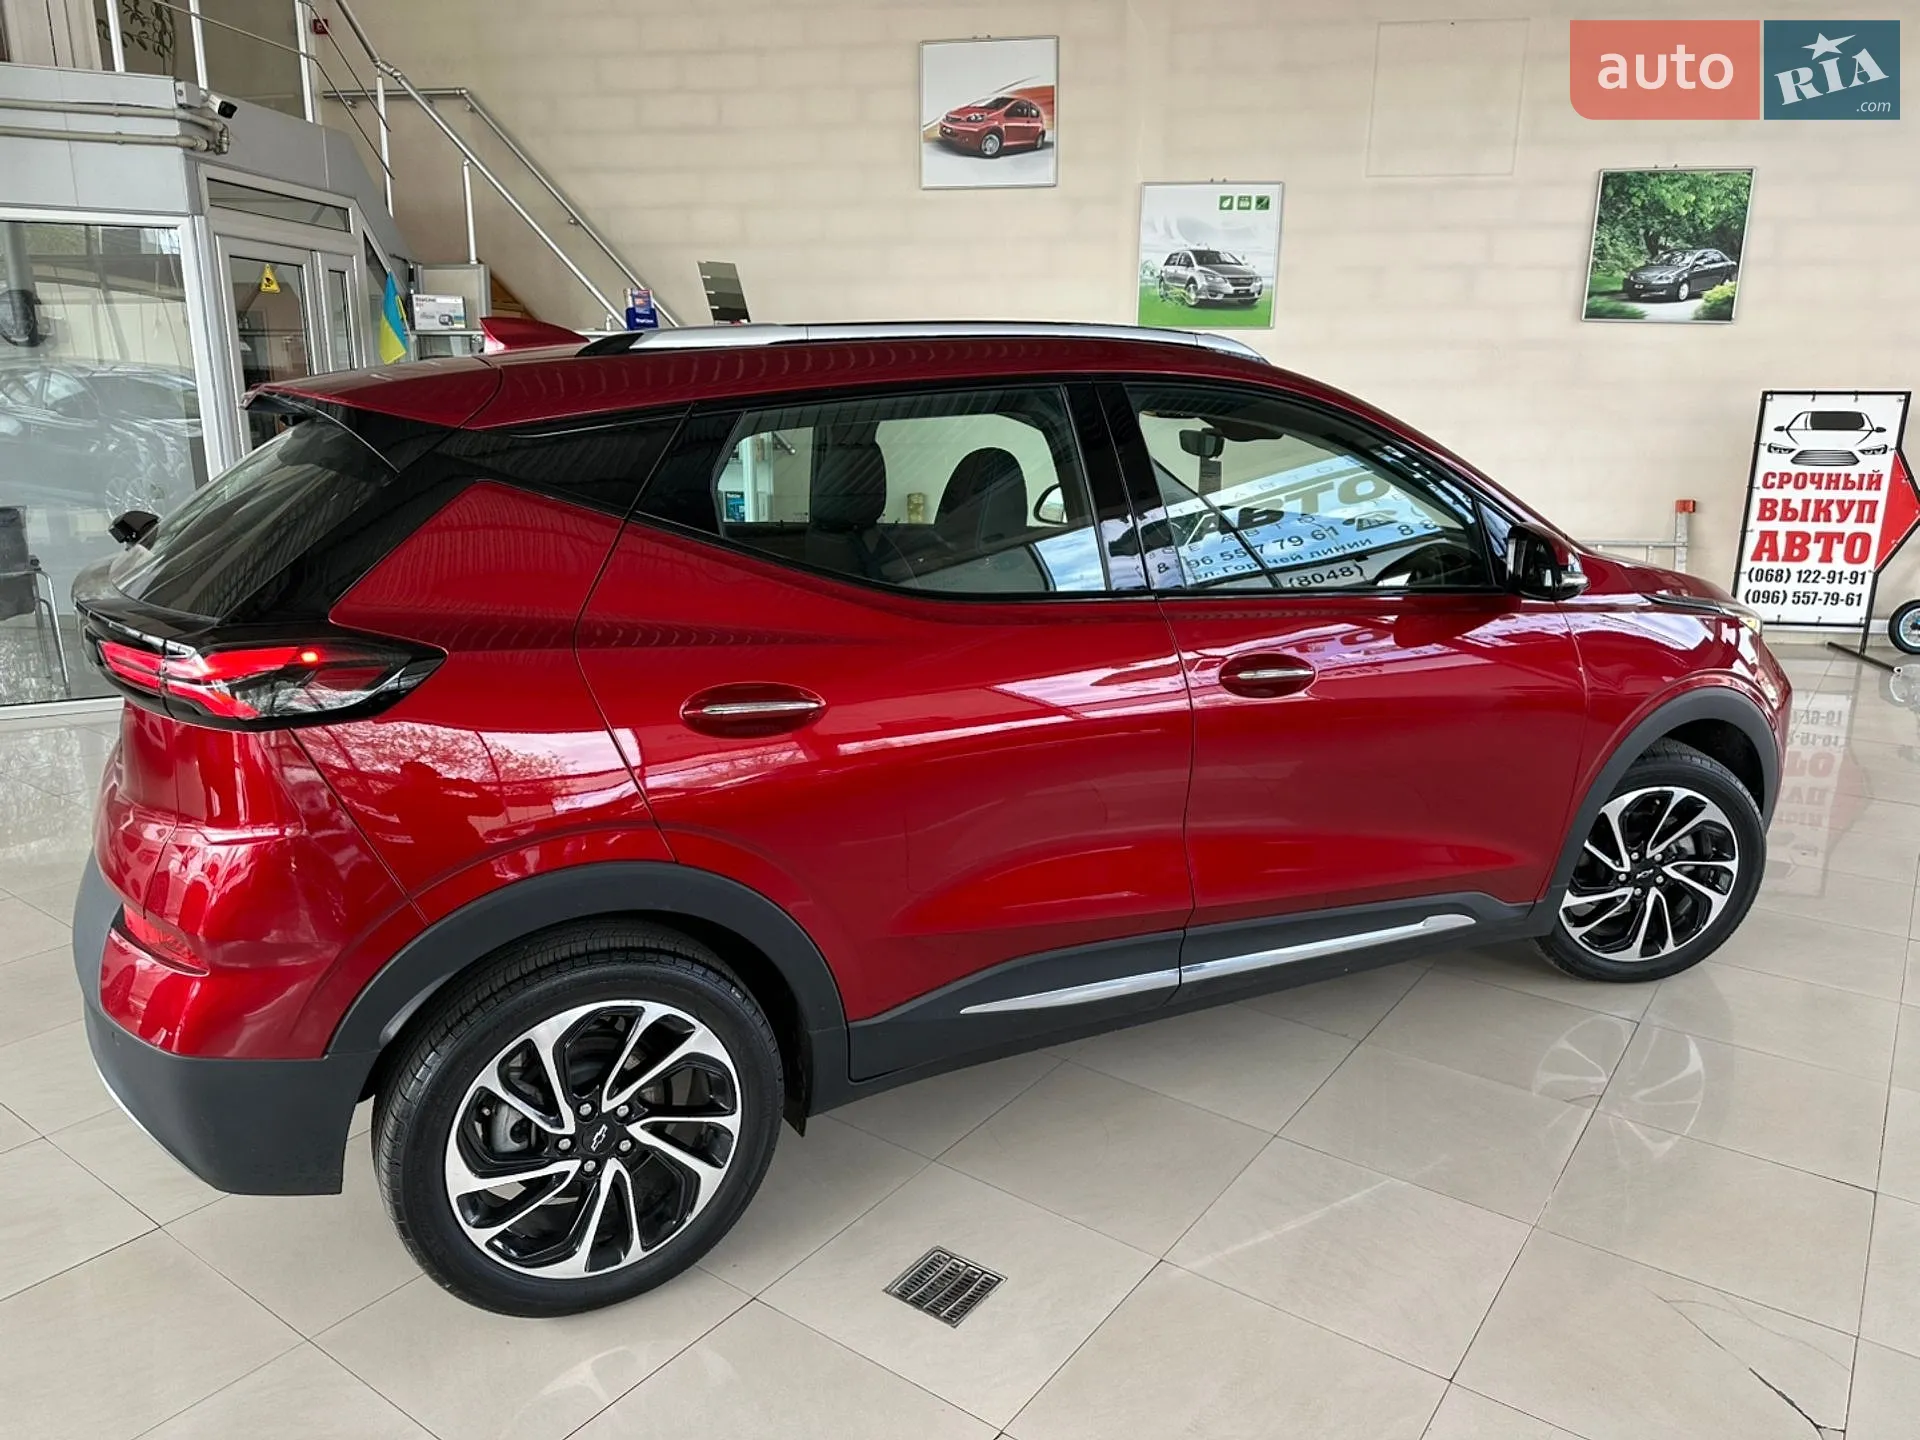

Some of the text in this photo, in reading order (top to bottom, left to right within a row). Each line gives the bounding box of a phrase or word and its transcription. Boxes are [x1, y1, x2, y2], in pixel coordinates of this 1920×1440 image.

[1761, 469, 1884, 491] СРОЧНЫЙ
[1756, 498, 1879, 524] ВЫКУП
[1272, 534, 1303, 551] 79
[1311, 526, 1340, 542] 61
[1310, 537, 1373, 559] линии
[1750, 530, 1873, 565] АВТО
[1288, 562, 1365, 588] (8048)
[1748, 567, 1867, 586] (068) 122-91-91
[1744, 589, 1863, 607] (096) 557-79-61
